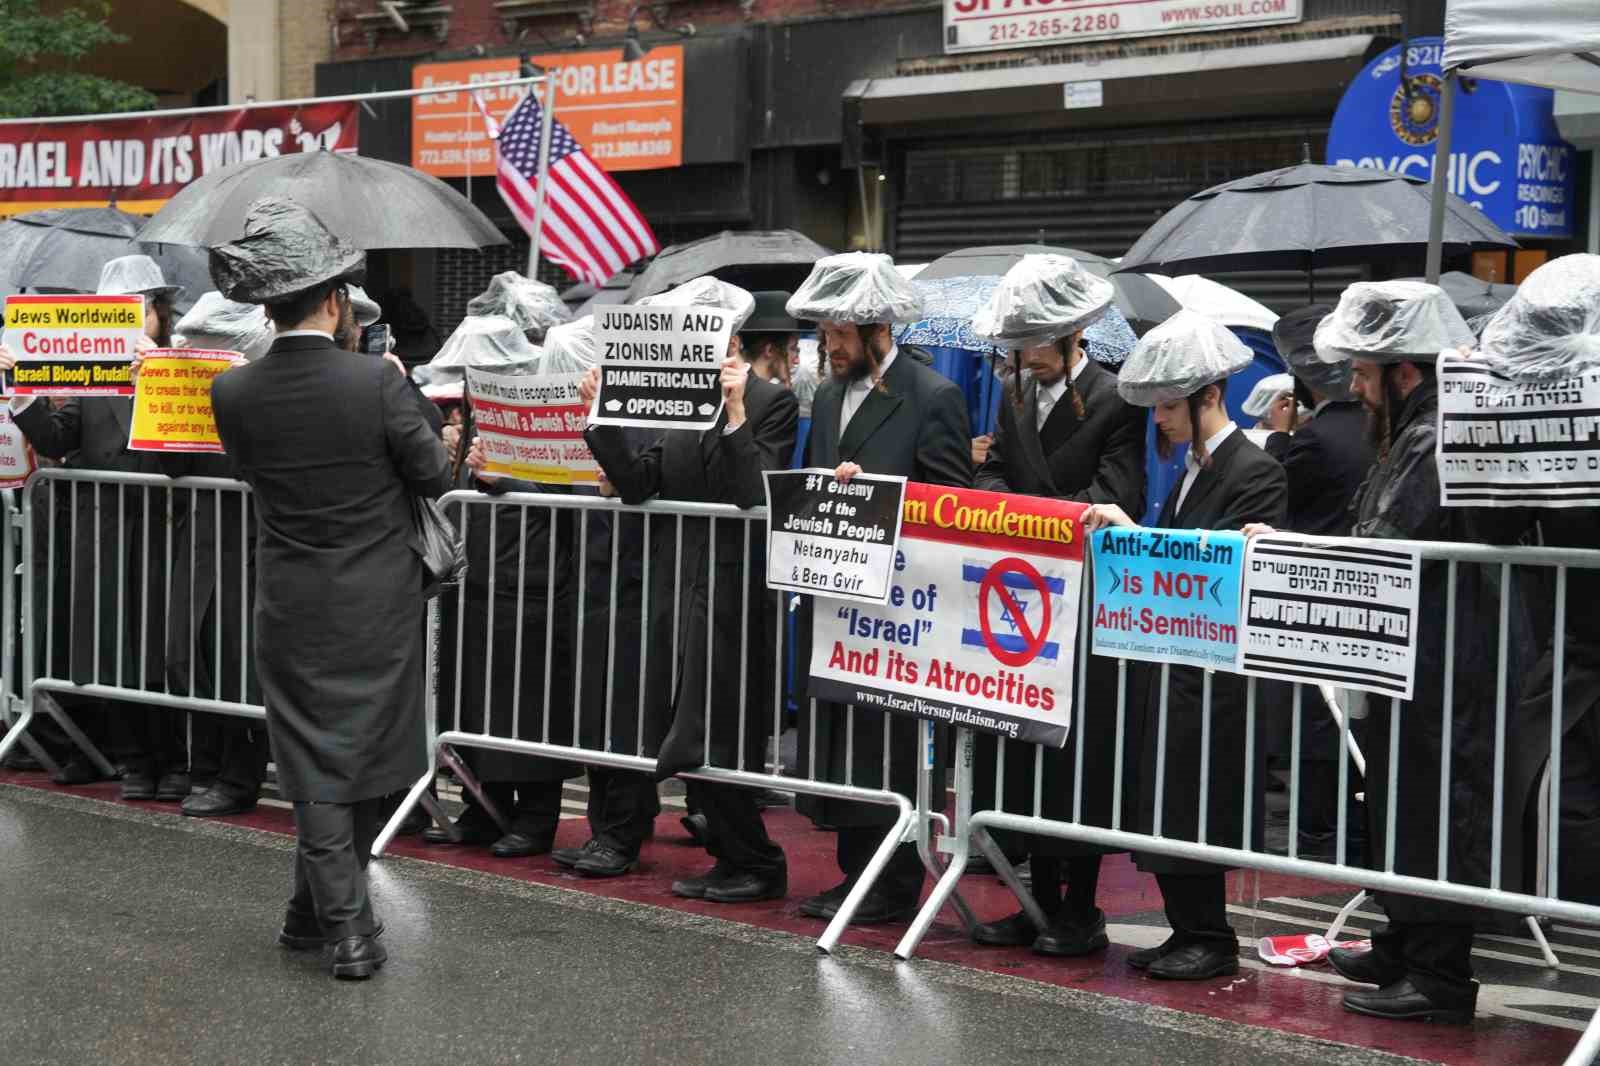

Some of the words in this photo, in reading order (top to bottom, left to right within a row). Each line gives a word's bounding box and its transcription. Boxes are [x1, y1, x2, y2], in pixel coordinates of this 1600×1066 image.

[990, 13, 1120, 40] 212-265-2280
[600, 60, 675, 94] LEASE
[79, 139, 145, 187] AND
[151, 136, 193, 184] ITS
[11, 309, 50, 324] Jews
[56, 308, 136, 323] Worldwide
[602, 313, 673, 331] JUDAISM
[682, 314, 724, 332] AND
[23, 331, 126, 354] Condemn
[605, 342, 673, 361] ZIONISM
[680, 344, 714, 362] ARE
[14, 365, 50, 382] Israeli
[53, 365, 91, 386] Bloody
[606, 370, 717, 389] DIAMETRICALLY
[519, 383, 566, 403] recognize
[1523, 391, 1582, 406] בגזירת
[626, 398, 693, 416] OPPOSED
[521, 416, 530, 431] a
[530, 411, 564, 432] Jewish
[805, 474, 823, 491] #1
[828, 481, 874, 501] enemy
[818, 501, 832, 513] of
[836, 502, 857, 516] the
[933, 493, 1074, 544] Condemns
[784, 514, 833, 535] Jewish
[837, 520, 885, 542] People
[793, 540, 868, 565] Netanyahu
[1101, 530, 1233, 565] Anti-Zionism
[792, 566, 799, 581] &
[802, 568, 828, 586] Ben
[833, 572, 864, 591] Gvir
[1252, 560, 1330, 579] המתפשרים
[1335, 568, 1379, 584] הכנסת
[1123, 568, 1143, 594] is
[1153, 570, 1209, 601] NOT
[1333, 581, 1377, 598] בגזירת
[1383, 574, 1412, 589] חברי
[912, 583, 937, 612] of
[1095, 603, 1237, 645] Anti-Semitism
[828, 641, 879, 676] And
[885, 650, 918, 684] its
[925, 658, 1055, 711] Atrocities
[856, 691, 1019, 738] www.IsraelVersusJudaism.org
